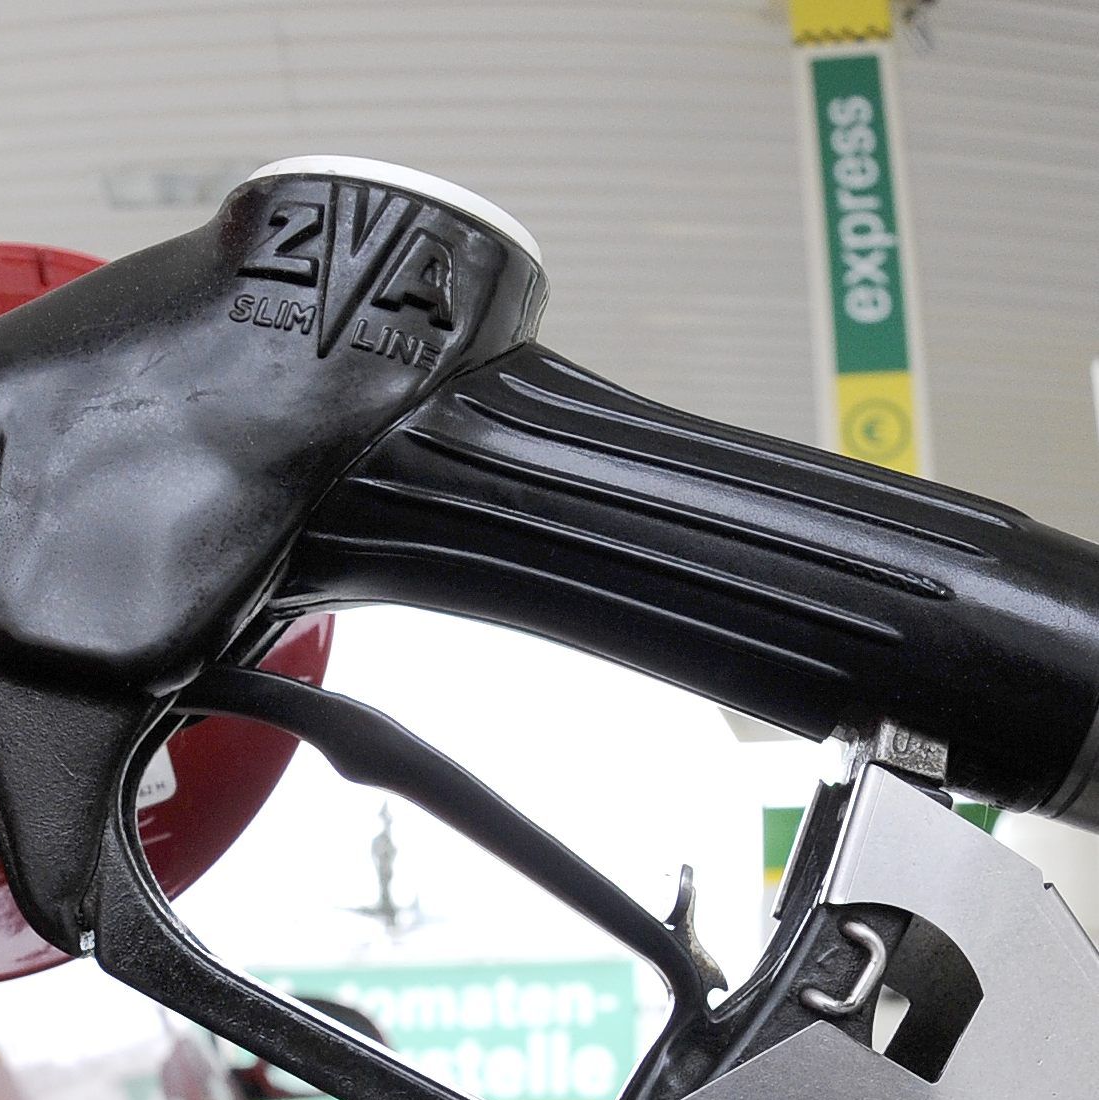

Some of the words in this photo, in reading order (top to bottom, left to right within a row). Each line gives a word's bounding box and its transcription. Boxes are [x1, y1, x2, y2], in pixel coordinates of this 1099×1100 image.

[237, 182, 455, 359] ZVA
[827, 95, 899, 324] express
[229, 294, 316, 335] SLIM
[351, 319, 442, 372] LINE
